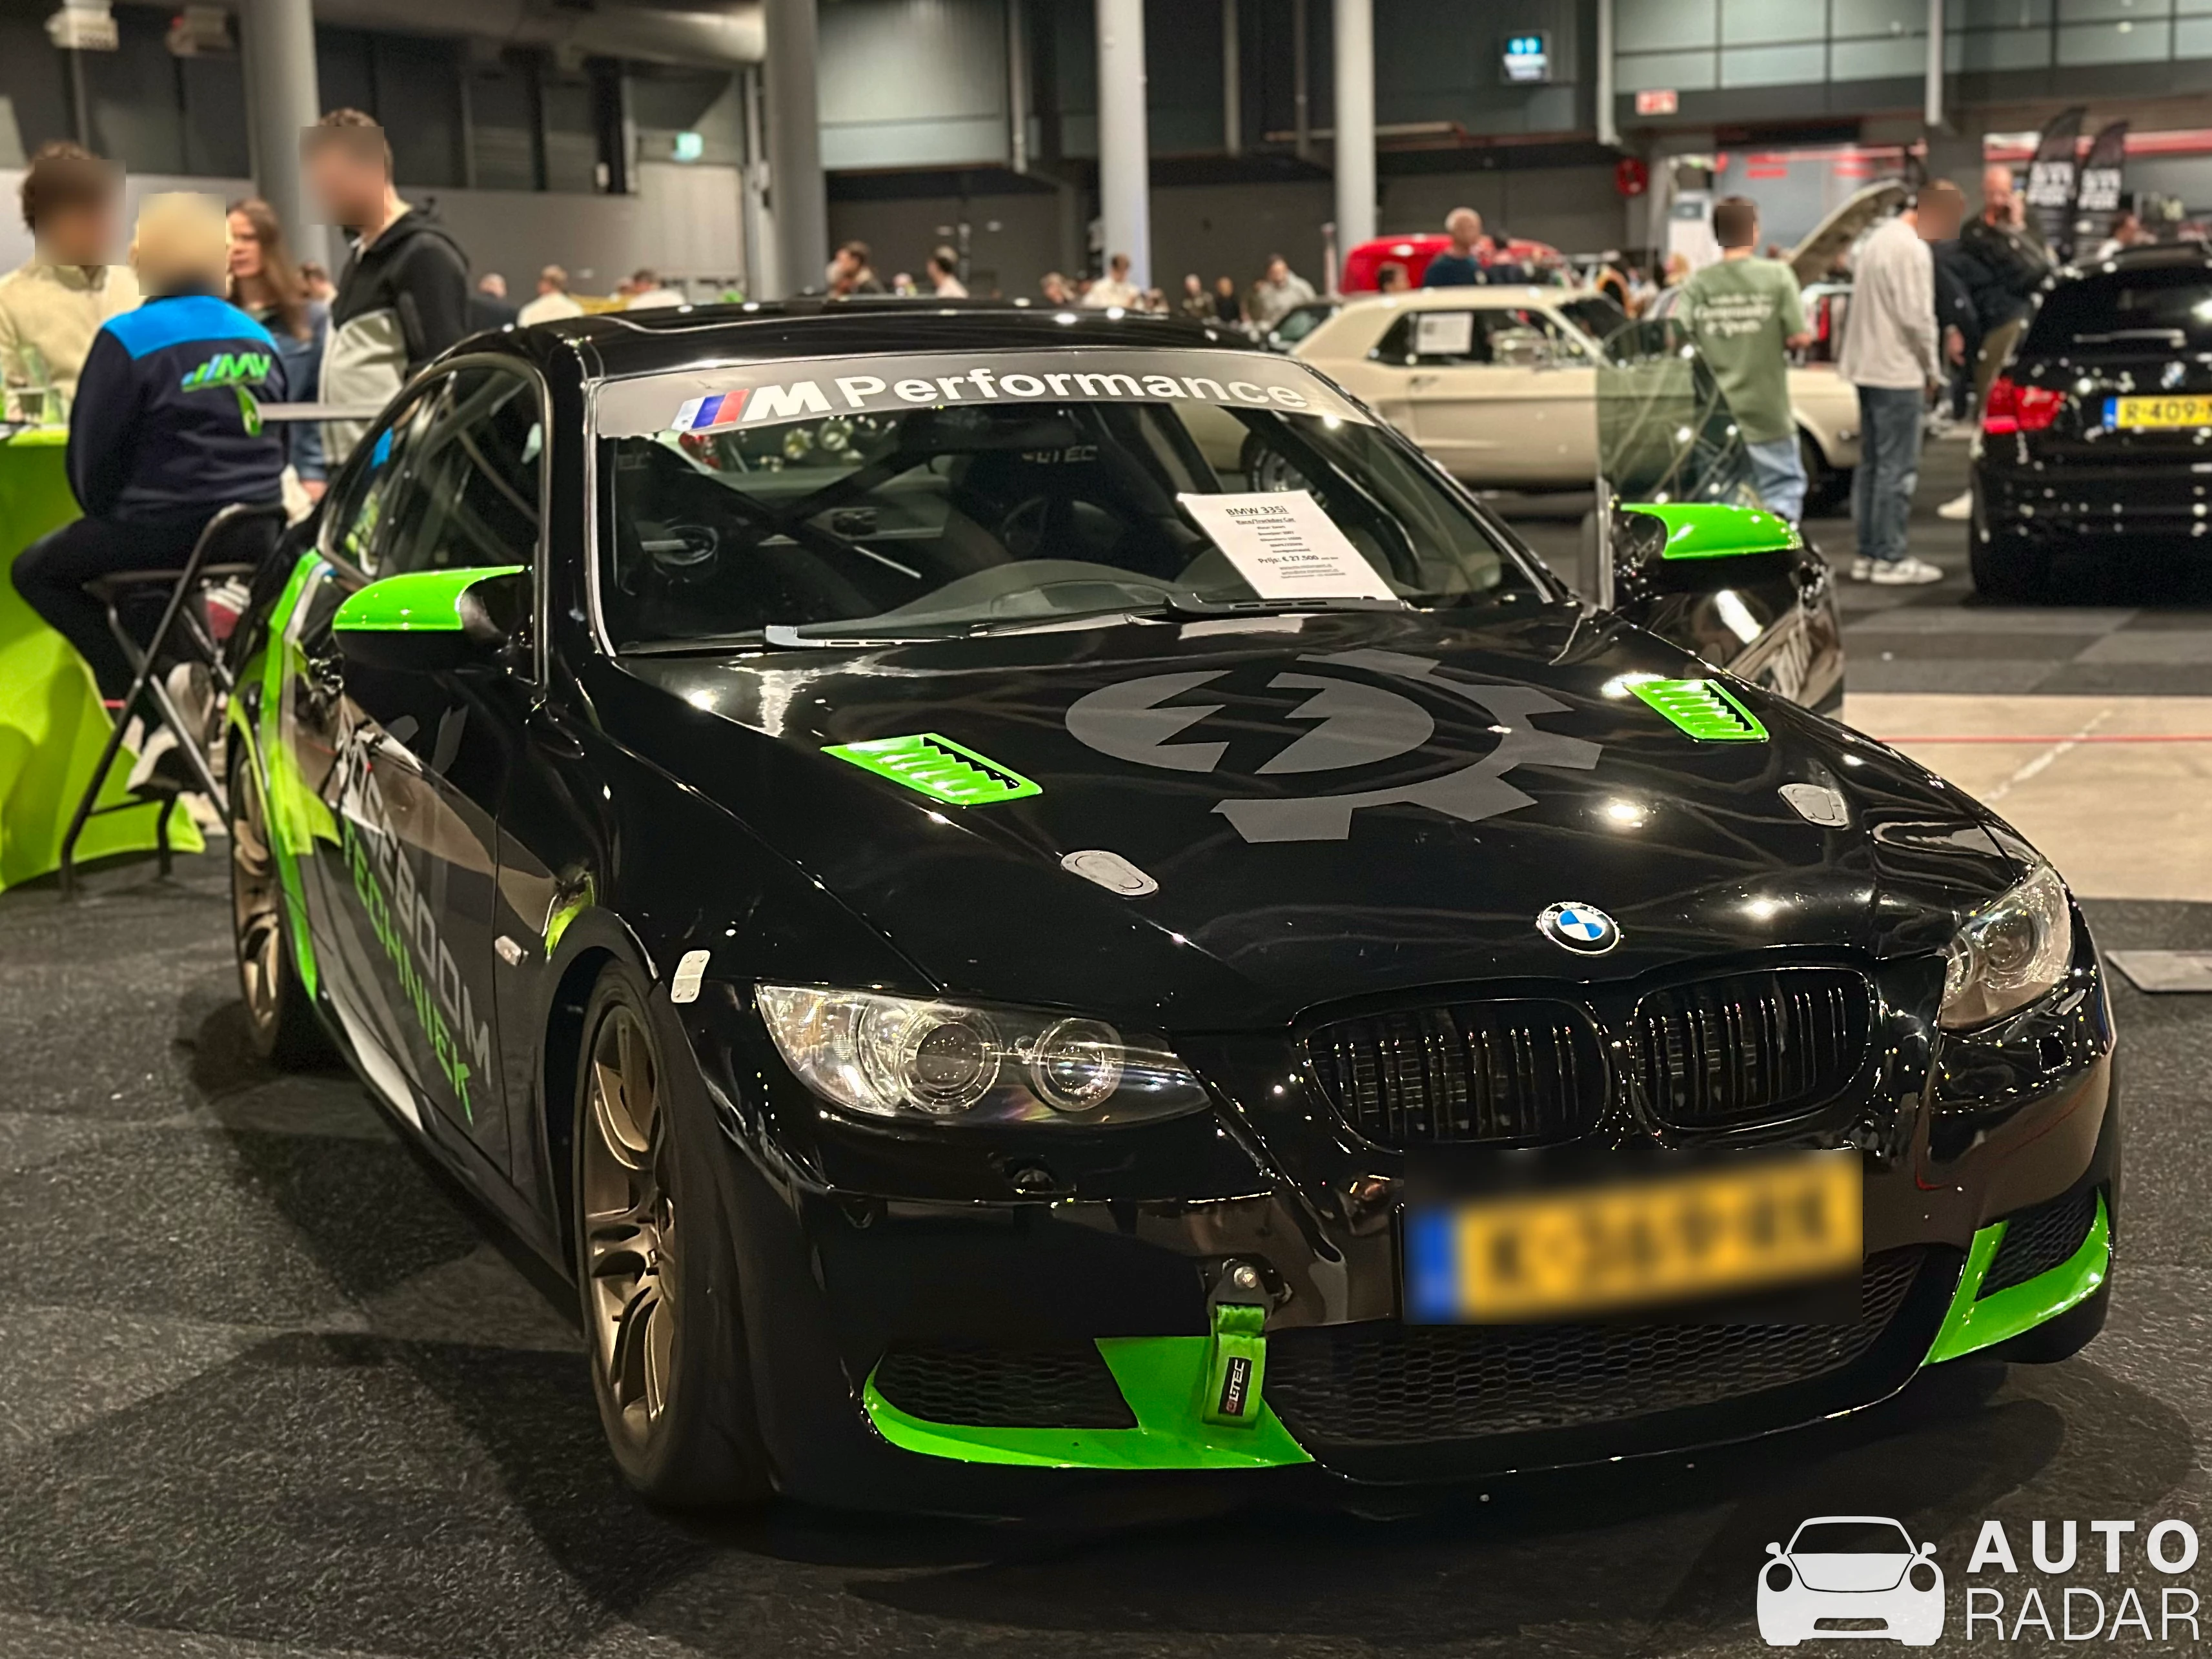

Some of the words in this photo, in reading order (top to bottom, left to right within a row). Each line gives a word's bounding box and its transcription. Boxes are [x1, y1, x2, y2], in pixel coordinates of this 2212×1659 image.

[742, 381, 833, 422] M
[835, 368, 1308, 408] Performance
[2126, 400, 2212, 420] R-409-
[1225, 507, 1259, 516] BMW
